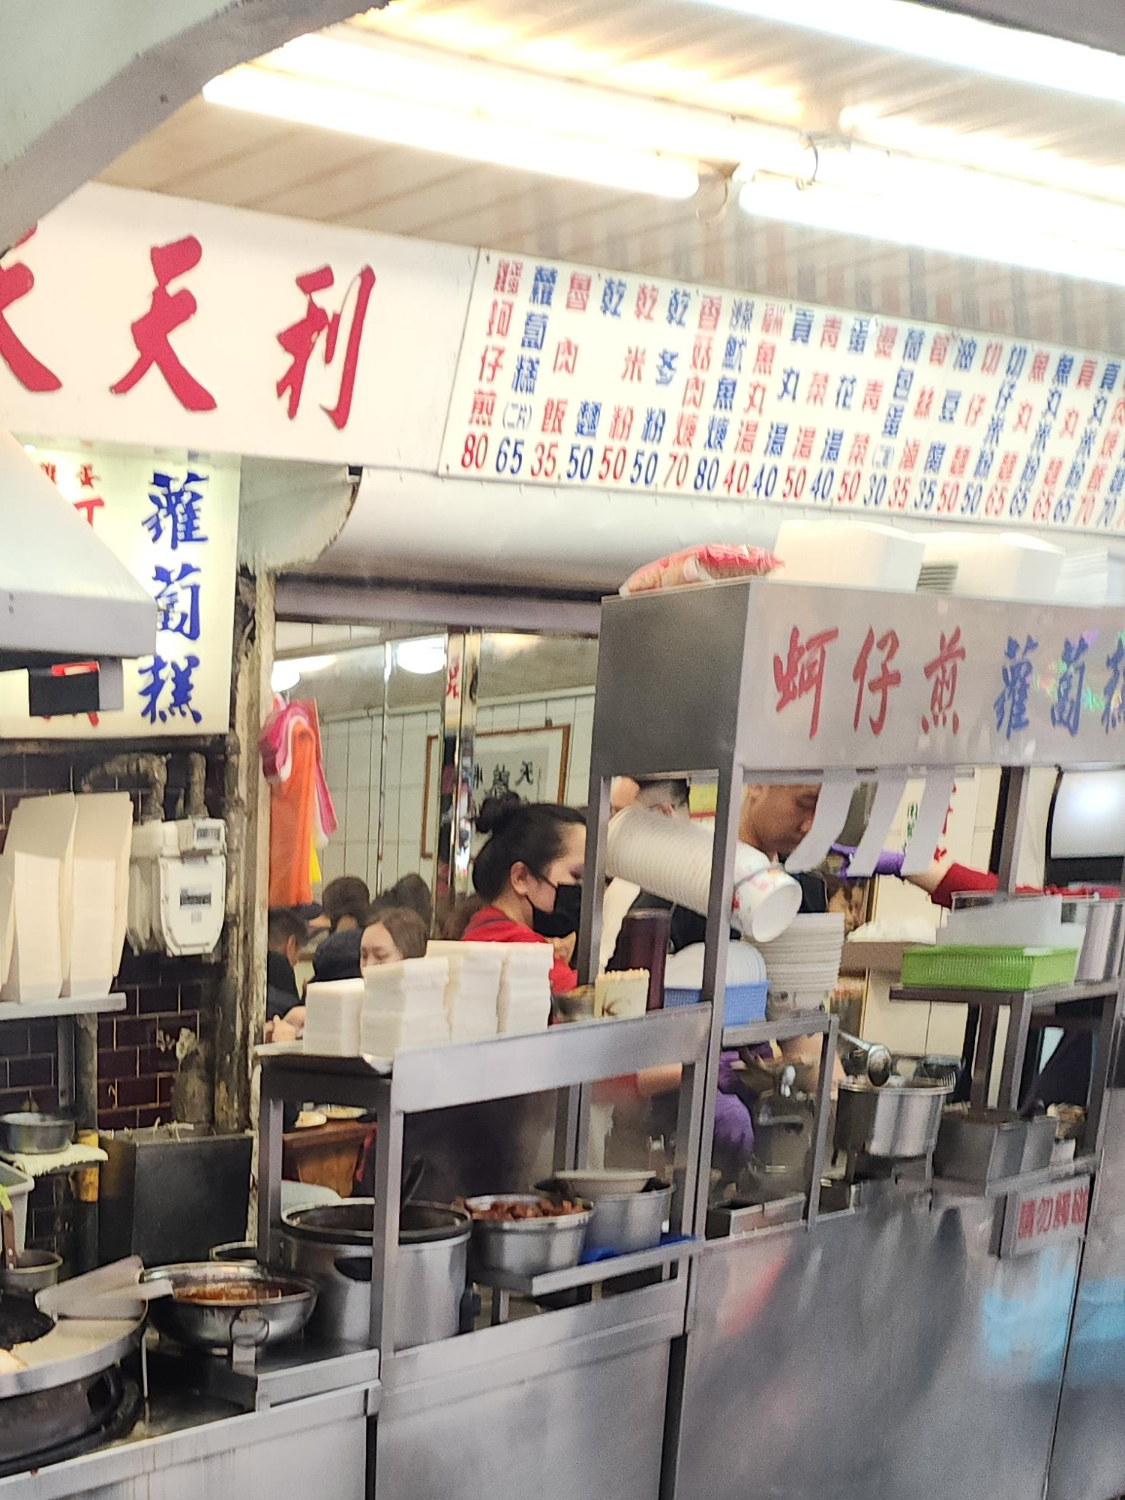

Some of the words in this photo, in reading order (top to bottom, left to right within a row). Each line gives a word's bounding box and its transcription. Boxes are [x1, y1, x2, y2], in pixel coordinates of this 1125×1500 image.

[512, 267, 558, 394] 蘿蔔糕
[575, 279, 626, 438] 乾麵
[608, 283, 658, 443] 乾米粉
[641, 288, 690, 443] 乾冬粉
[734, 306, 783, 456] 福州魚丸湯
[765, 308, 815, 456] 貢丸湯
[792, 318, 840, 461] 青菜湯
[822, 317, 872, 462] 蛋花湯
[847, 327, 896, 468] 燙青菜
[924, 337, 978, 472] 油豆腐
[948, 344, 1002, 480] 切仔麵
[995, 353, 1049, 486] 魚丸麵
[1041, 360, 1096, 490] 貢丸麵
[1066, 360, 1123, 489] 貢丸米粉
[460, 431, 489, 471] 80
[495, 438, 524, 474] 65
[530, 441, 559, 477] 35
[567, 444, 594, 480] 50
[597, 445, 627, 484] 50
[630, 450, 659, 485] 50
[663, 451, 689, 490] 70
[693, 456, 719, 491] 80
[723, 460, 750, 496] 40
[751, 465, 779, 498] 40
[782, 465, 807, 501] 50
[810, 468, 834, 501] 40
[836, 470, 862, 504] 50
[864, 474, 887, 506] 30
[885, 475, 912, 510] 35
[915, 480, 936, 509] 35
[935, 480, 961, 514] 50
[960, 484, 984, 513] 50
[984, 485, 1008, 517] 65
[1010, 487, 1030, 514] 65
[1032, 490, 1055, 522] 65
[1053, 494, 1074, 520] 65
[1075, 494, 1095, 525] 70
[773, 623, 966, 741] 蚵仔煎
